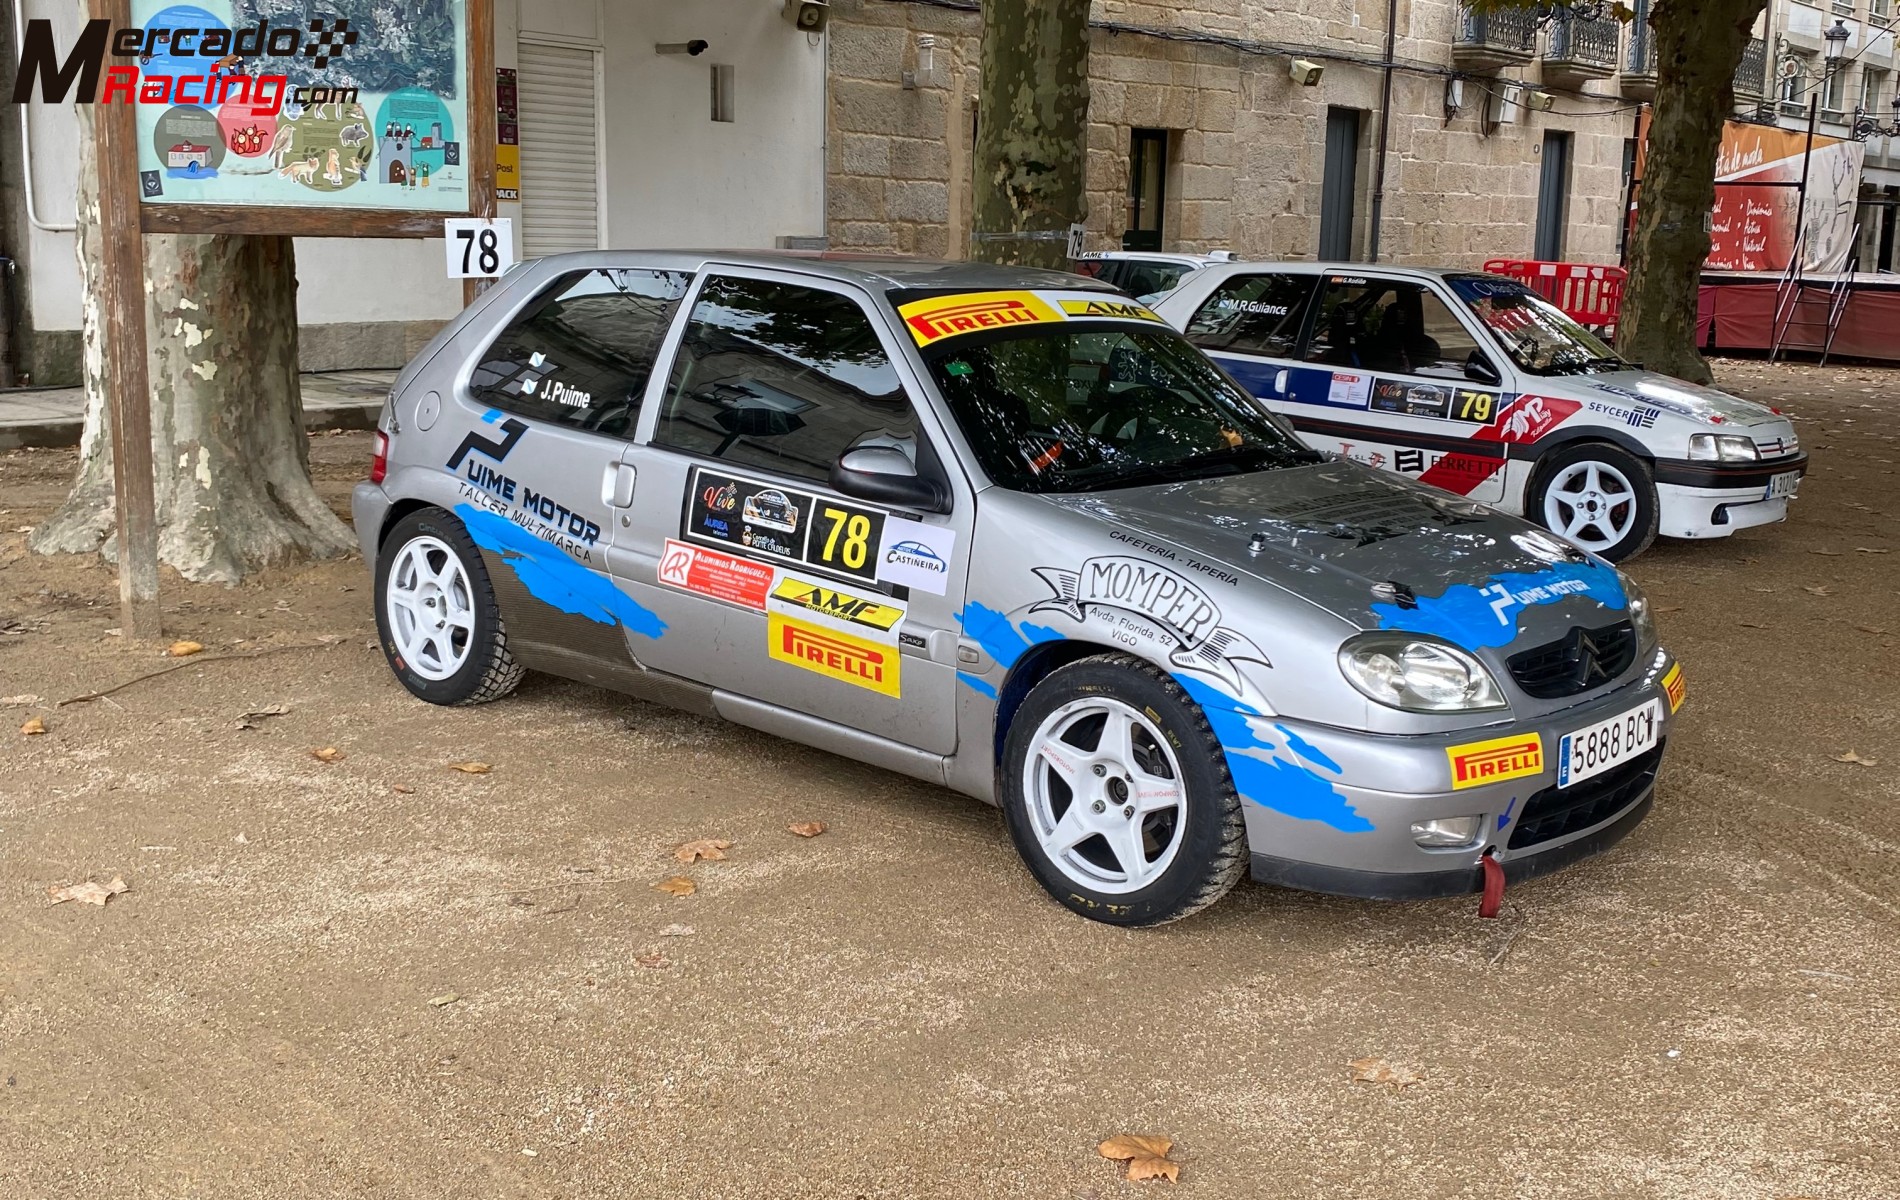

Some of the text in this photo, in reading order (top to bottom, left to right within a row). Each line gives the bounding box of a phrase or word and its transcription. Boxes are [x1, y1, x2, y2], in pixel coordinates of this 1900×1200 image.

[496, 164, 513, 173] Post
[456, 229, 499, 274] 78
[1071, 225, 1083, 257] 79
[906, 300, 1039, 339] PIRELLI
[1086, 302, 1147, 317] AMF
[540, 380, 590, 408] J.Puime
[1460, 391, 1491, 420] 79
[1588, 402, 1629, 419] SEYCER
[1431, 455, 1499, 475] FERRETTI
[703, 486, 735, 510] Vive
[459, 482, 591, 563] TALLER MULTIMARCA
[522, 486, 600, 545] MOTOR
[822, 507, 870, 568] 78
[1109, 530, 1238, 586] CAFETERÍA TAPERÍA
[794, 588, 880, 617] AMF
[1090, 562, 1213, 642] MOMPER
[1544, 579, 1591, 596] MOTOR
[806, 602, 853, 621] MOTORSPORT
[1089, 606, 1173, 647] Avda. Florida, 52
[783, 625, 883, 683] PIRELLI
[1111, 631, 1138, 647] VIGO
[1453, 742, 1539, 781] PIRELLI
[1574, 723, 1620, 773] 5888
